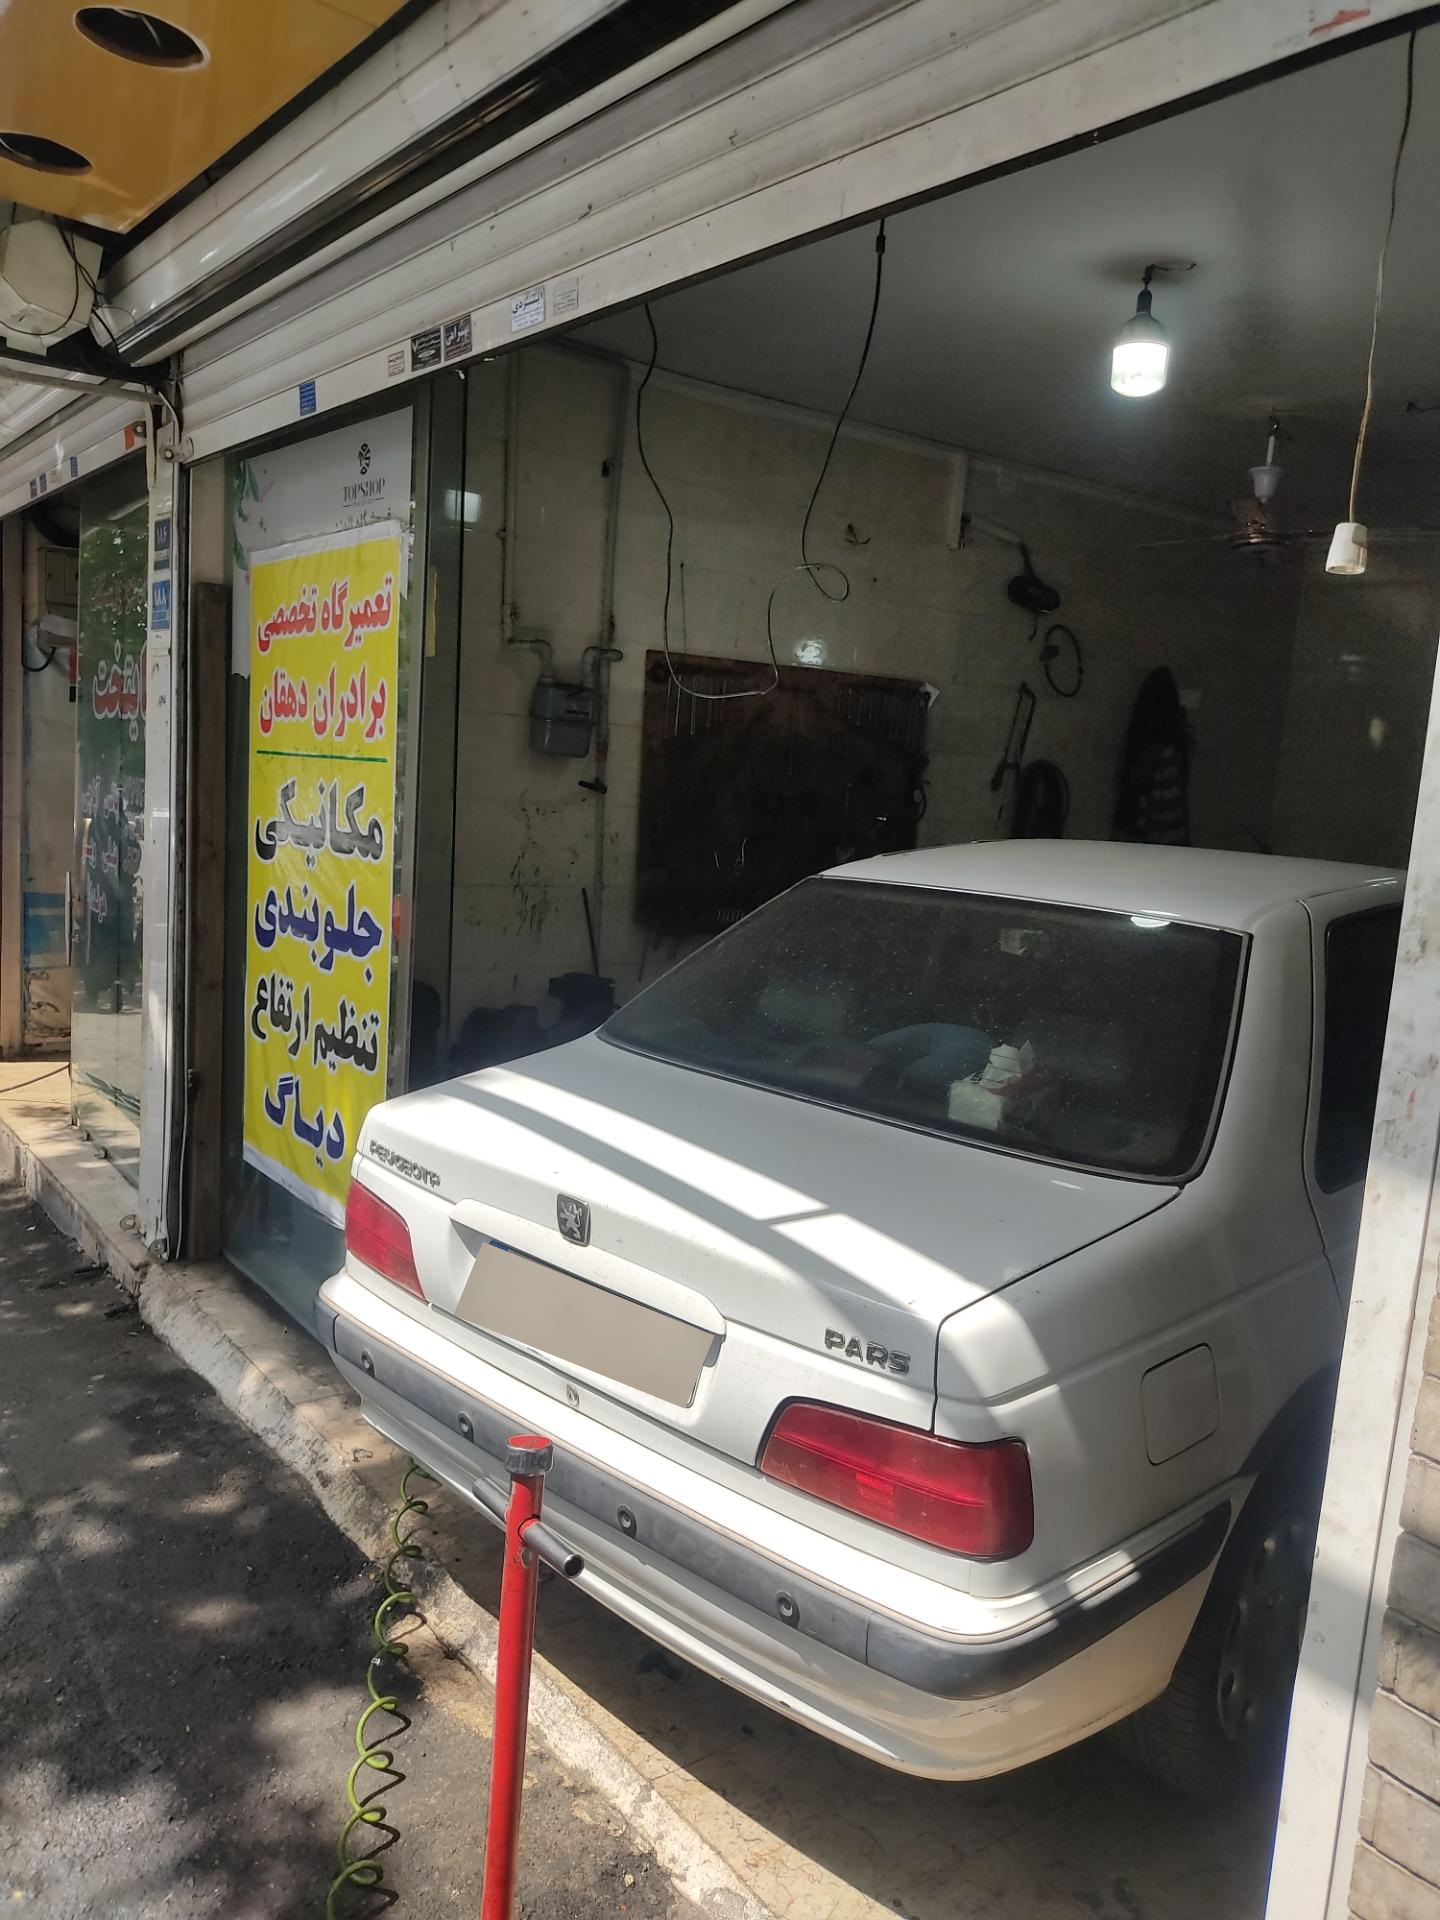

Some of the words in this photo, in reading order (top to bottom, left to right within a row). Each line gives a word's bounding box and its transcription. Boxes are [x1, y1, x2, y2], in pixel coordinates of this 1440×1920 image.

[342, 476, 387, 503] TOPSHOP
[257, 586, 317, 653] تخصصی
[92, 638, 148, 741] ایتخت
[259, 669, 308, 734] دهقان
[313, 664, 387, 738] برادران
[255, 779, 384, 868] مکانیکی
[255, 883, 383, 983] جلوبندی
[251, 972, 311, 1057] ارتفاع
[313, 999, 380, 1072] تنظیم
[264, 1075, 345, 1168] دیاگ
[824, 1327, 911, 1376] PARS
